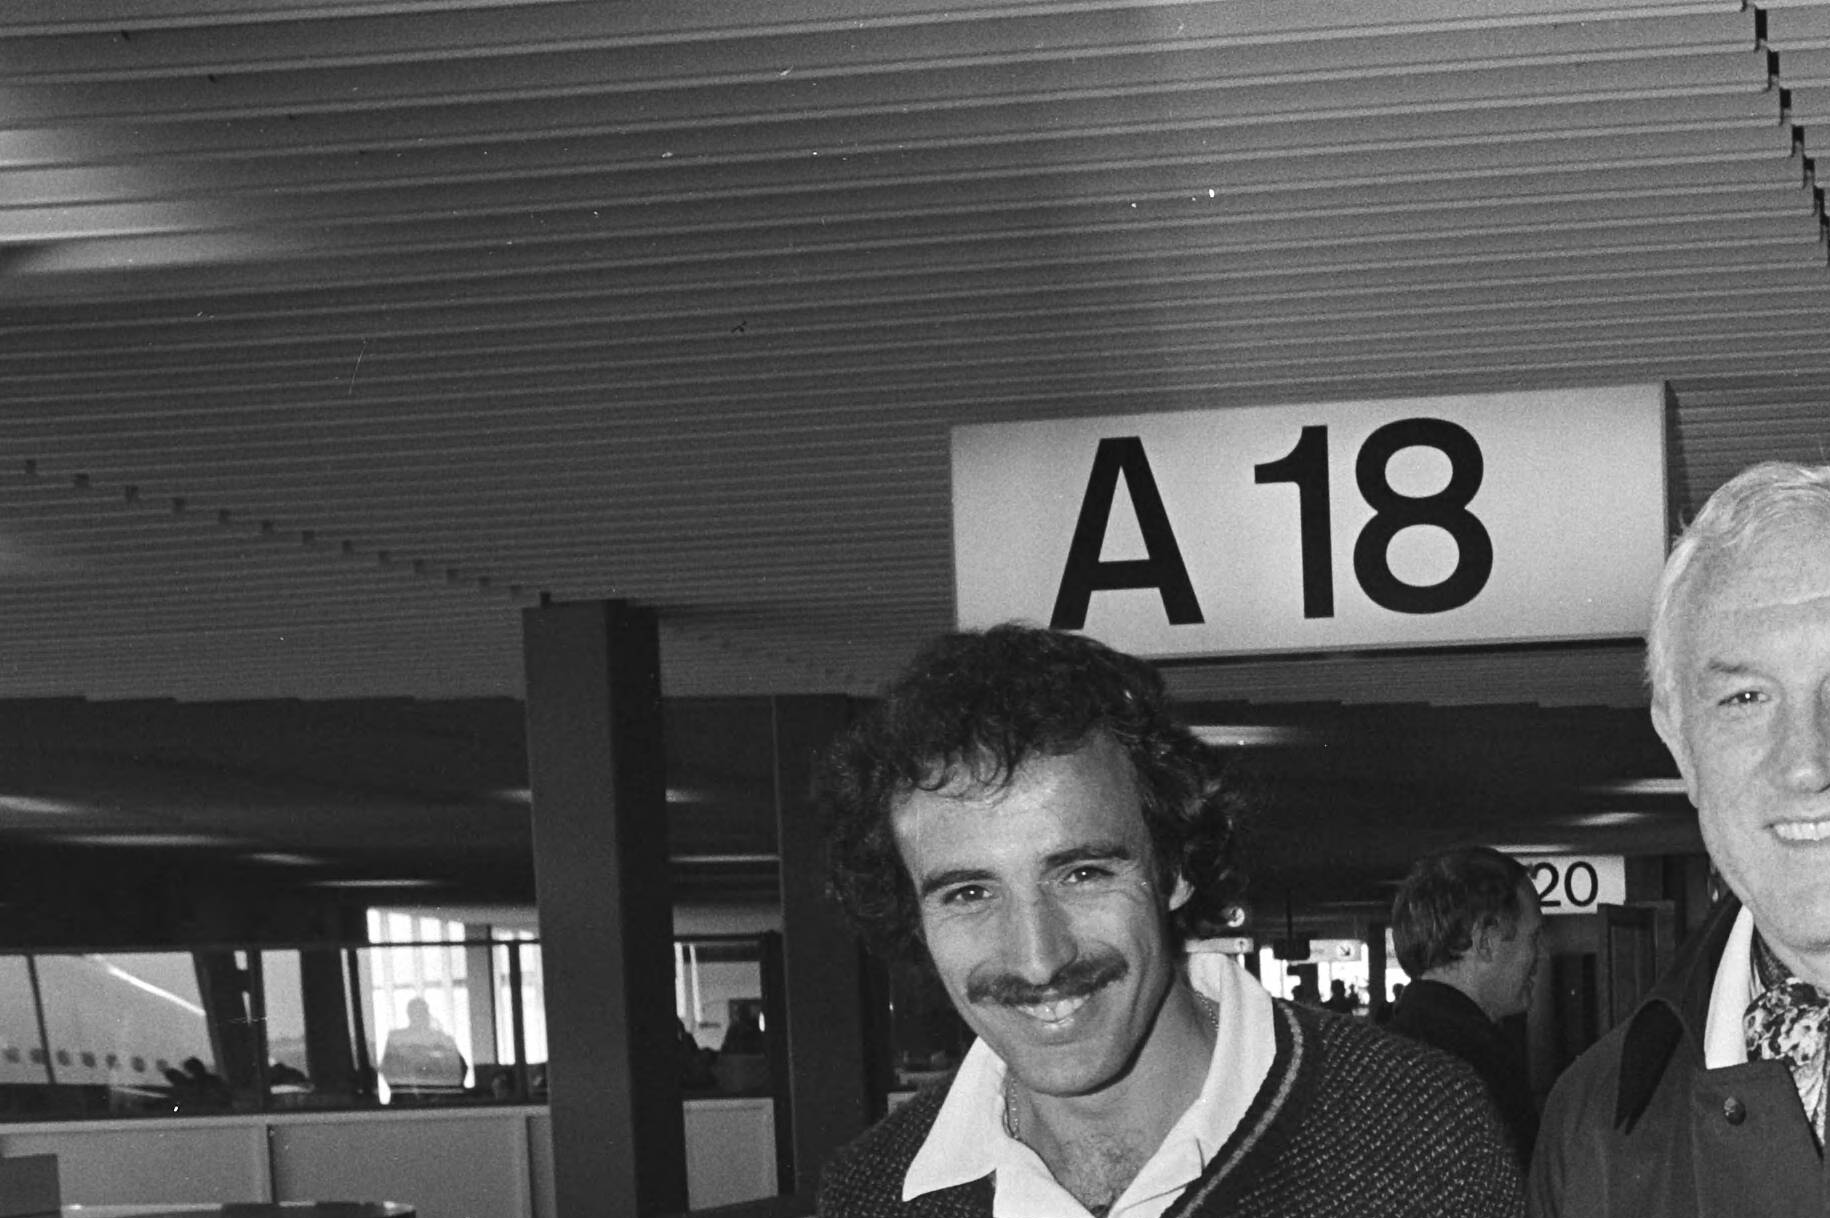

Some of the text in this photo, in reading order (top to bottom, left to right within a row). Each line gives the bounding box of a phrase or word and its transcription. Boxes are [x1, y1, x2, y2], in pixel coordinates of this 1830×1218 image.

[1048, 417, 1494, 630] A 18
[1531, 861, 1598, 907] 20
